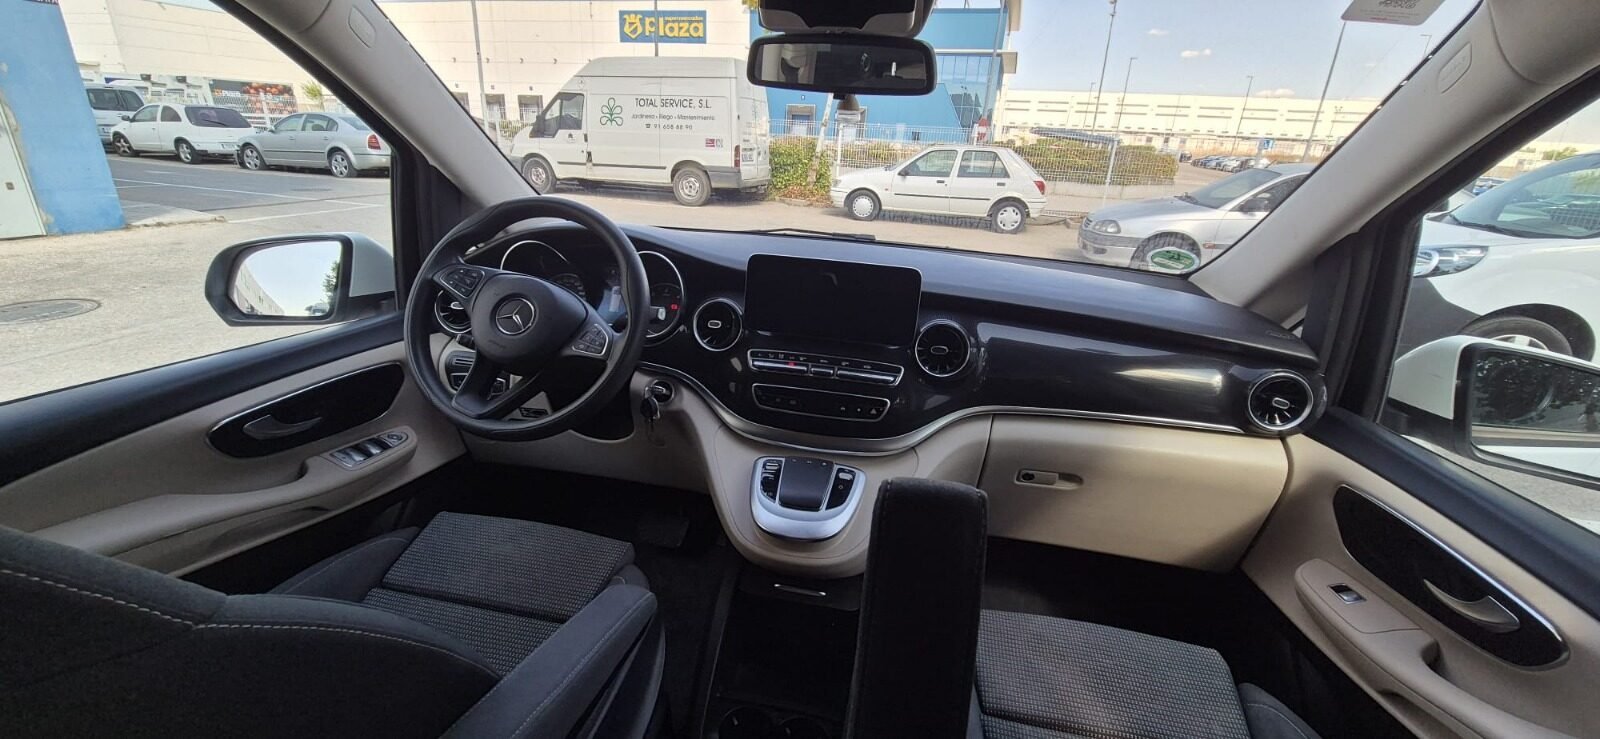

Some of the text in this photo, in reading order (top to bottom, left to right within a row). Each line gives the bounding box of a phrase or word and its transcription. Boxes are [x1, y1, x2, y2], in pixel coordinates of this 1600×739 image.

[635, 97, 712, 109] TOTAL SERVICE, S.L.
